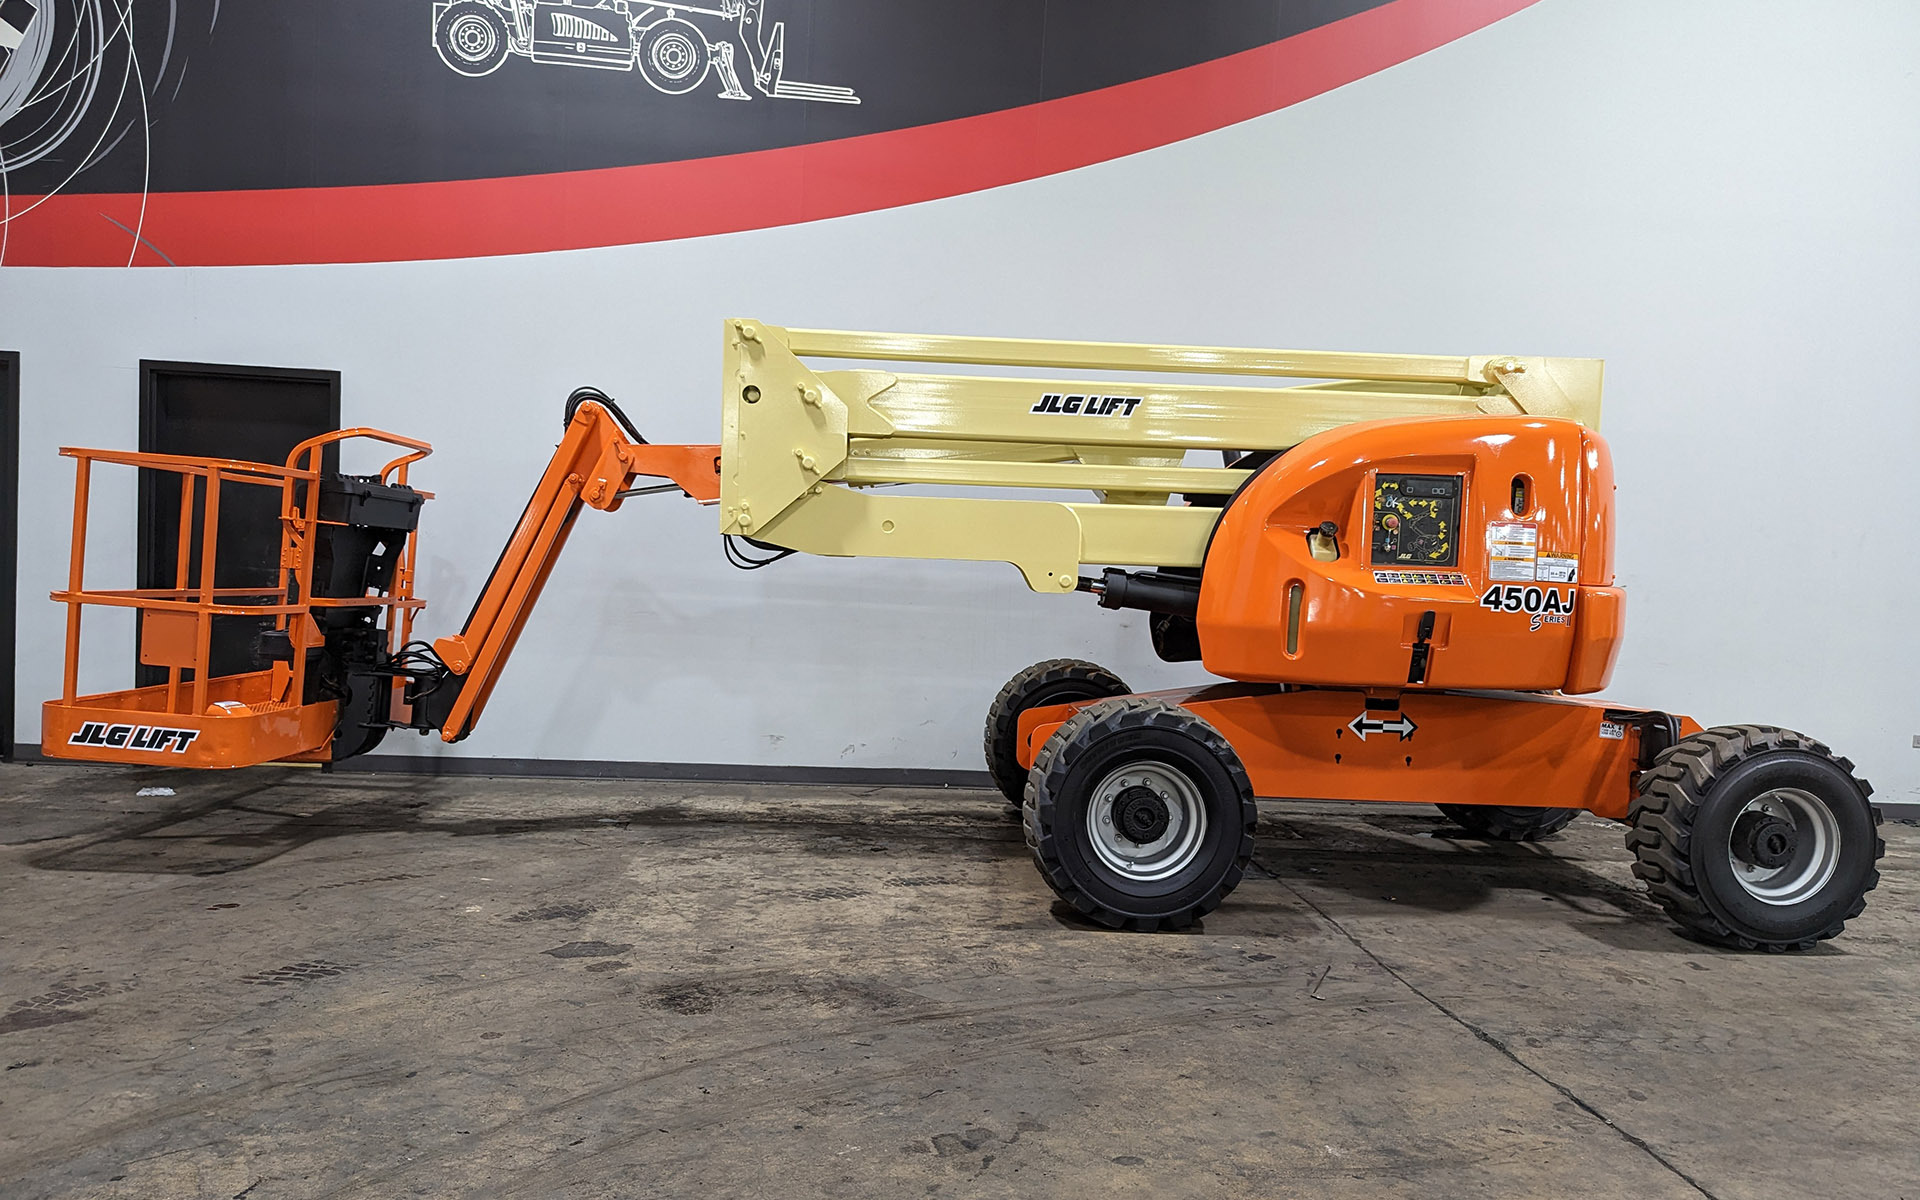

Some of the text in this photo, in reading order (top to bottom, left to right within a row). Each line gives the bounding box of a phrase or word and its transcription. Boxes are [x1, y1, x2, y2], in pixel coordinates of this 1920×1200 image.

[1031, 394, 1142, 417] JLG LIFT
[1482, 585, 1575, 615] 450AJ
[70, 723, 198, 751] JLG LIFT
